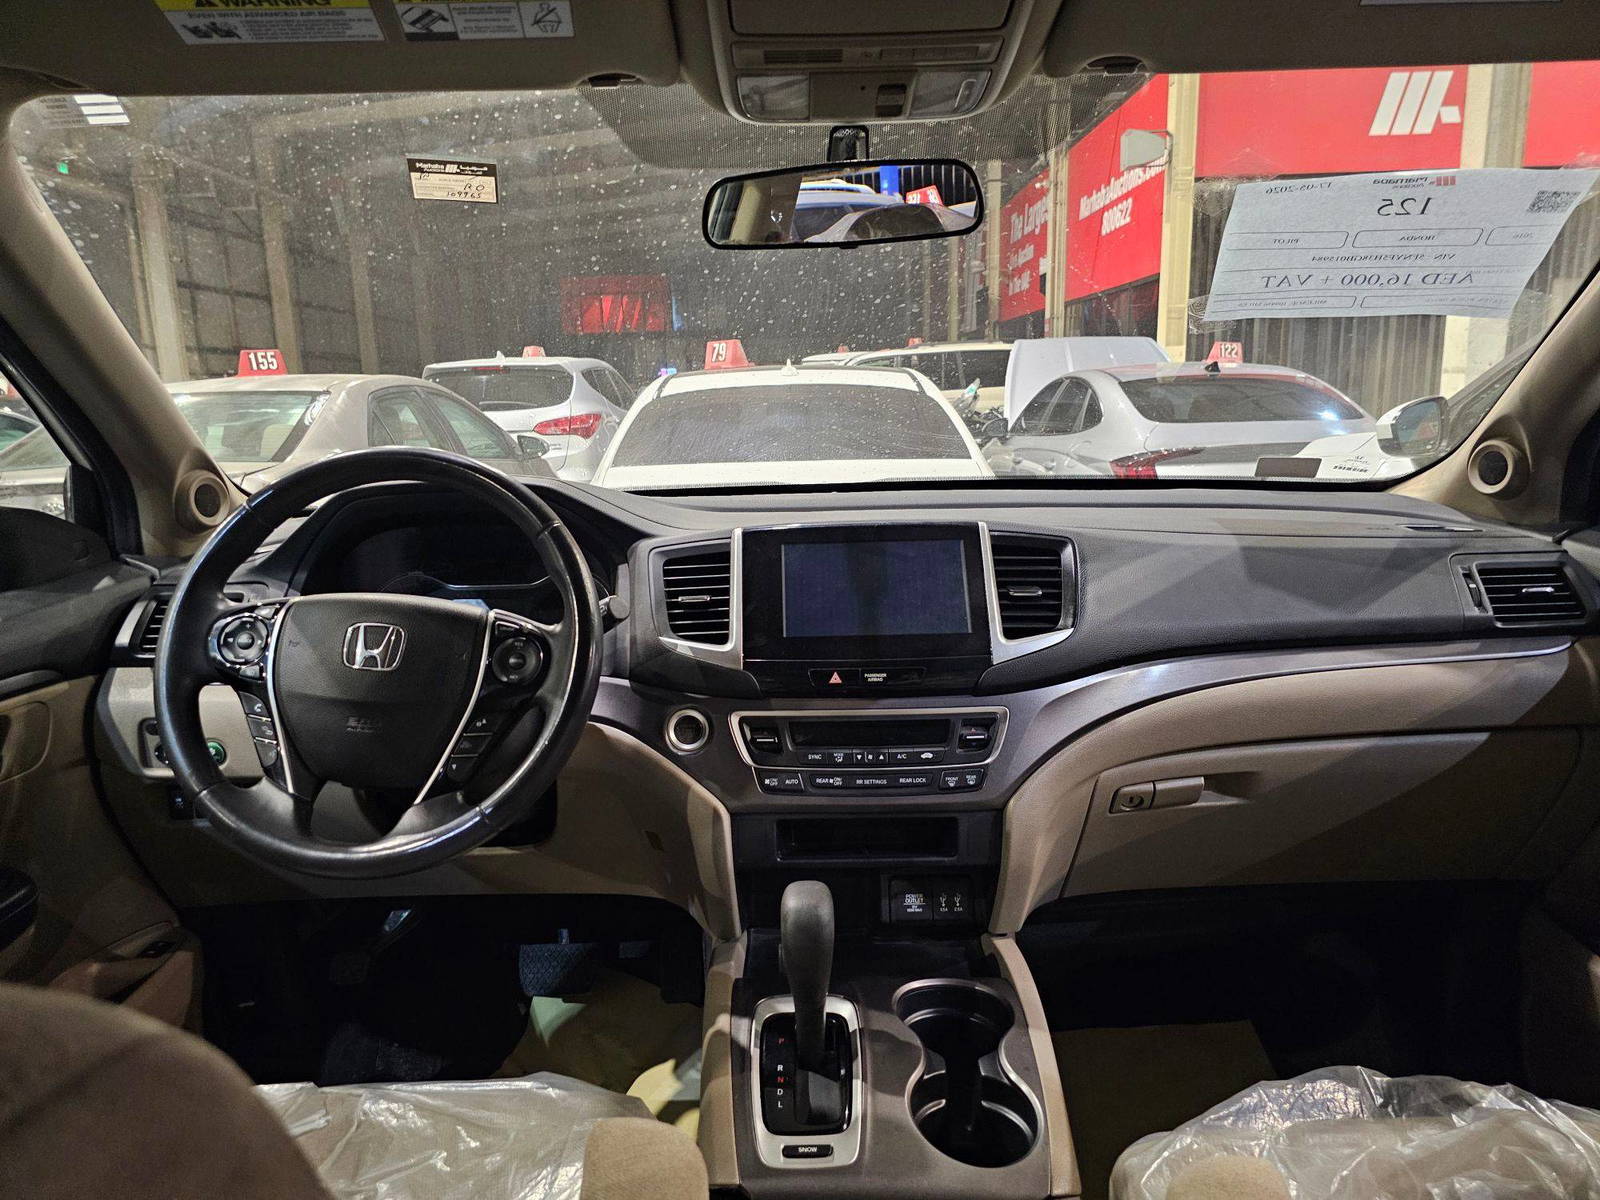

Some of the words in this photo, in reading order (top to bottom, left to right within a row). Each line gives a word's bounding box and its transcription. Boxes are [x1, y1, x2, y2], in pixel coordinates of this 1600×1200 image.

[711, 343, 727, 362] 79
[1220, 343, 1238, 358] 122
[249, 351, 278, 370] 155
[777, 1064, 784, 1072] R
[777, 1088, 784, 1096] D
